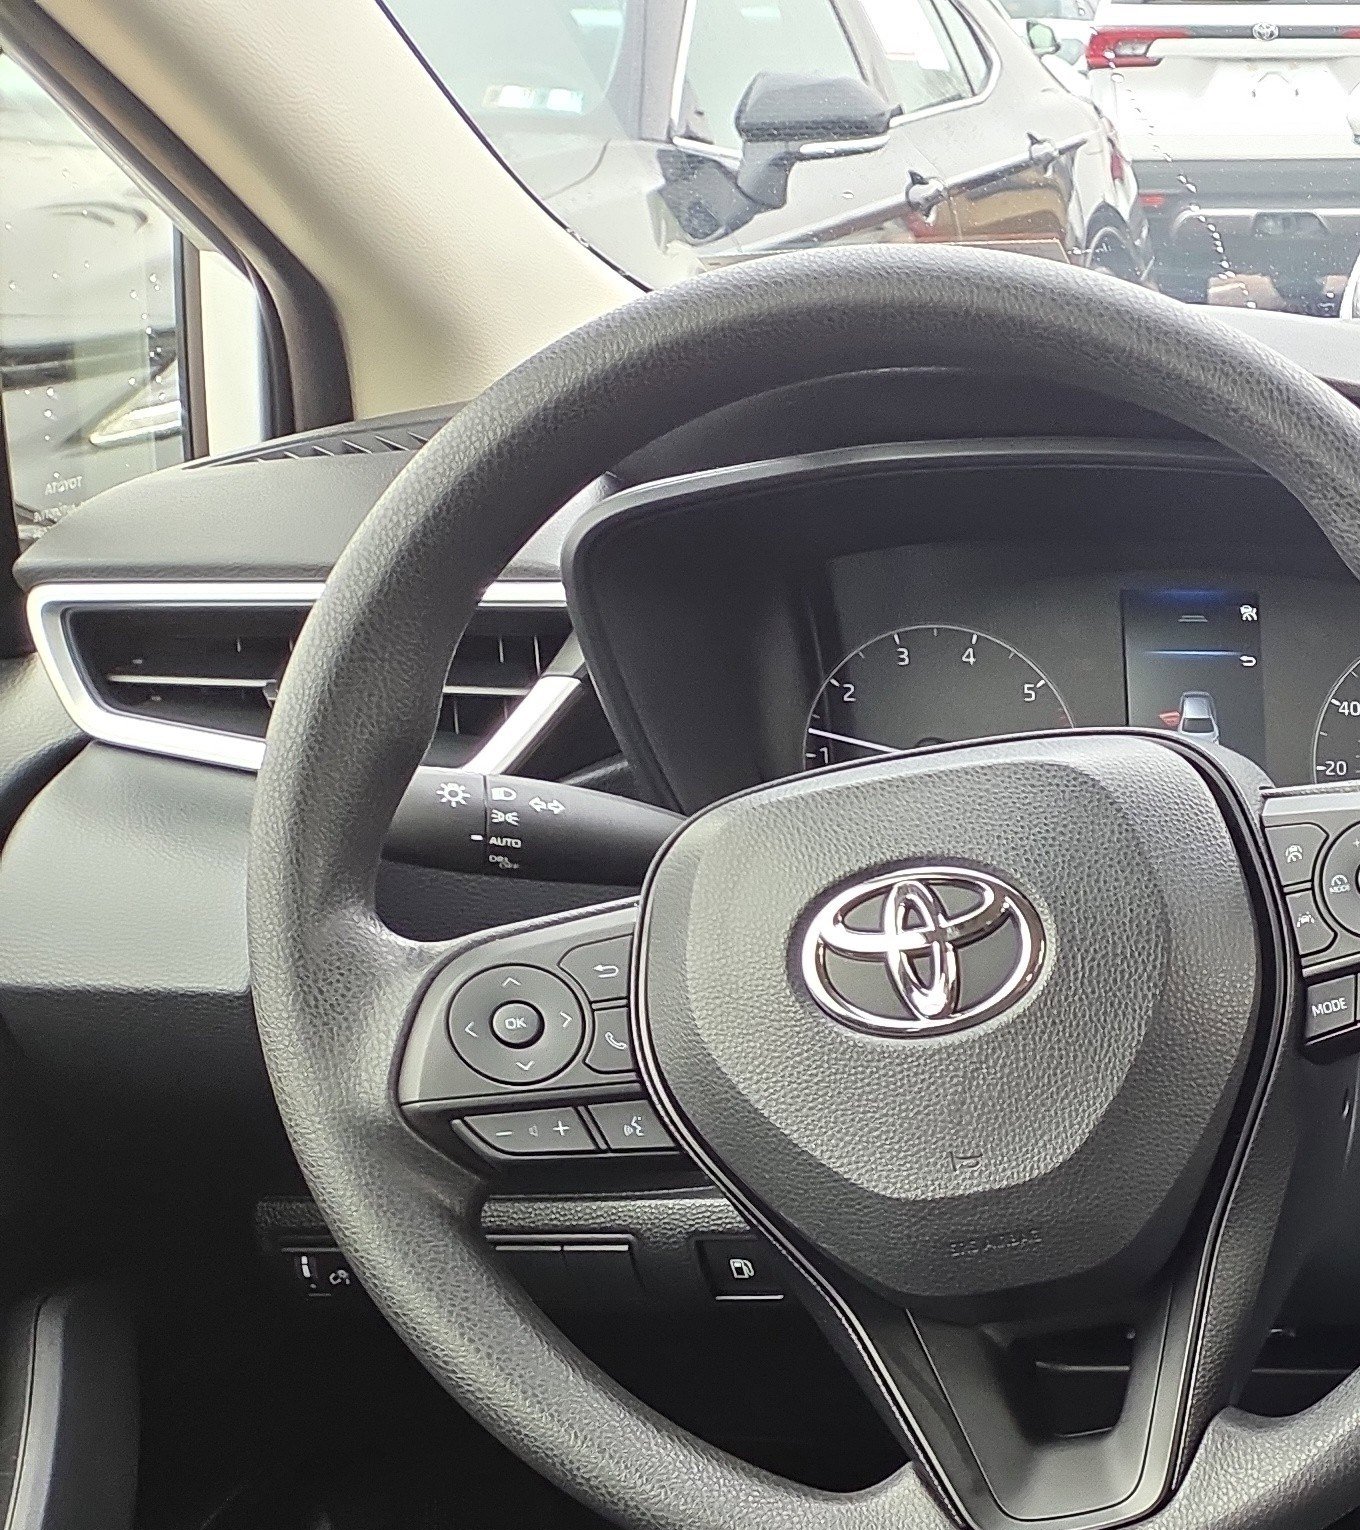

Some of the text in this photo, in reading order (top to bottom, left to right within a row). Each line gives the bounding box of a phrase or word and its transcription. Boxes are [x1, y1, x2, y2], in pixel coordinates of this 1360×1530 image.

[897, 648, 911, 666] 3
[961, 648, 977, 666] 4
[842, 684, 857, 702] 2
[1023, 684, 1037, 702] 5
[1338, 702, 1360, 716] 40
[818, 748, 829, 764] 1
[1324, 761, 1347, 775] 20
[489, 836, 522, 848] AUTO
[1311, 997, 1348, 1017] MODE
[504, 1016, 527, 1030] OK
